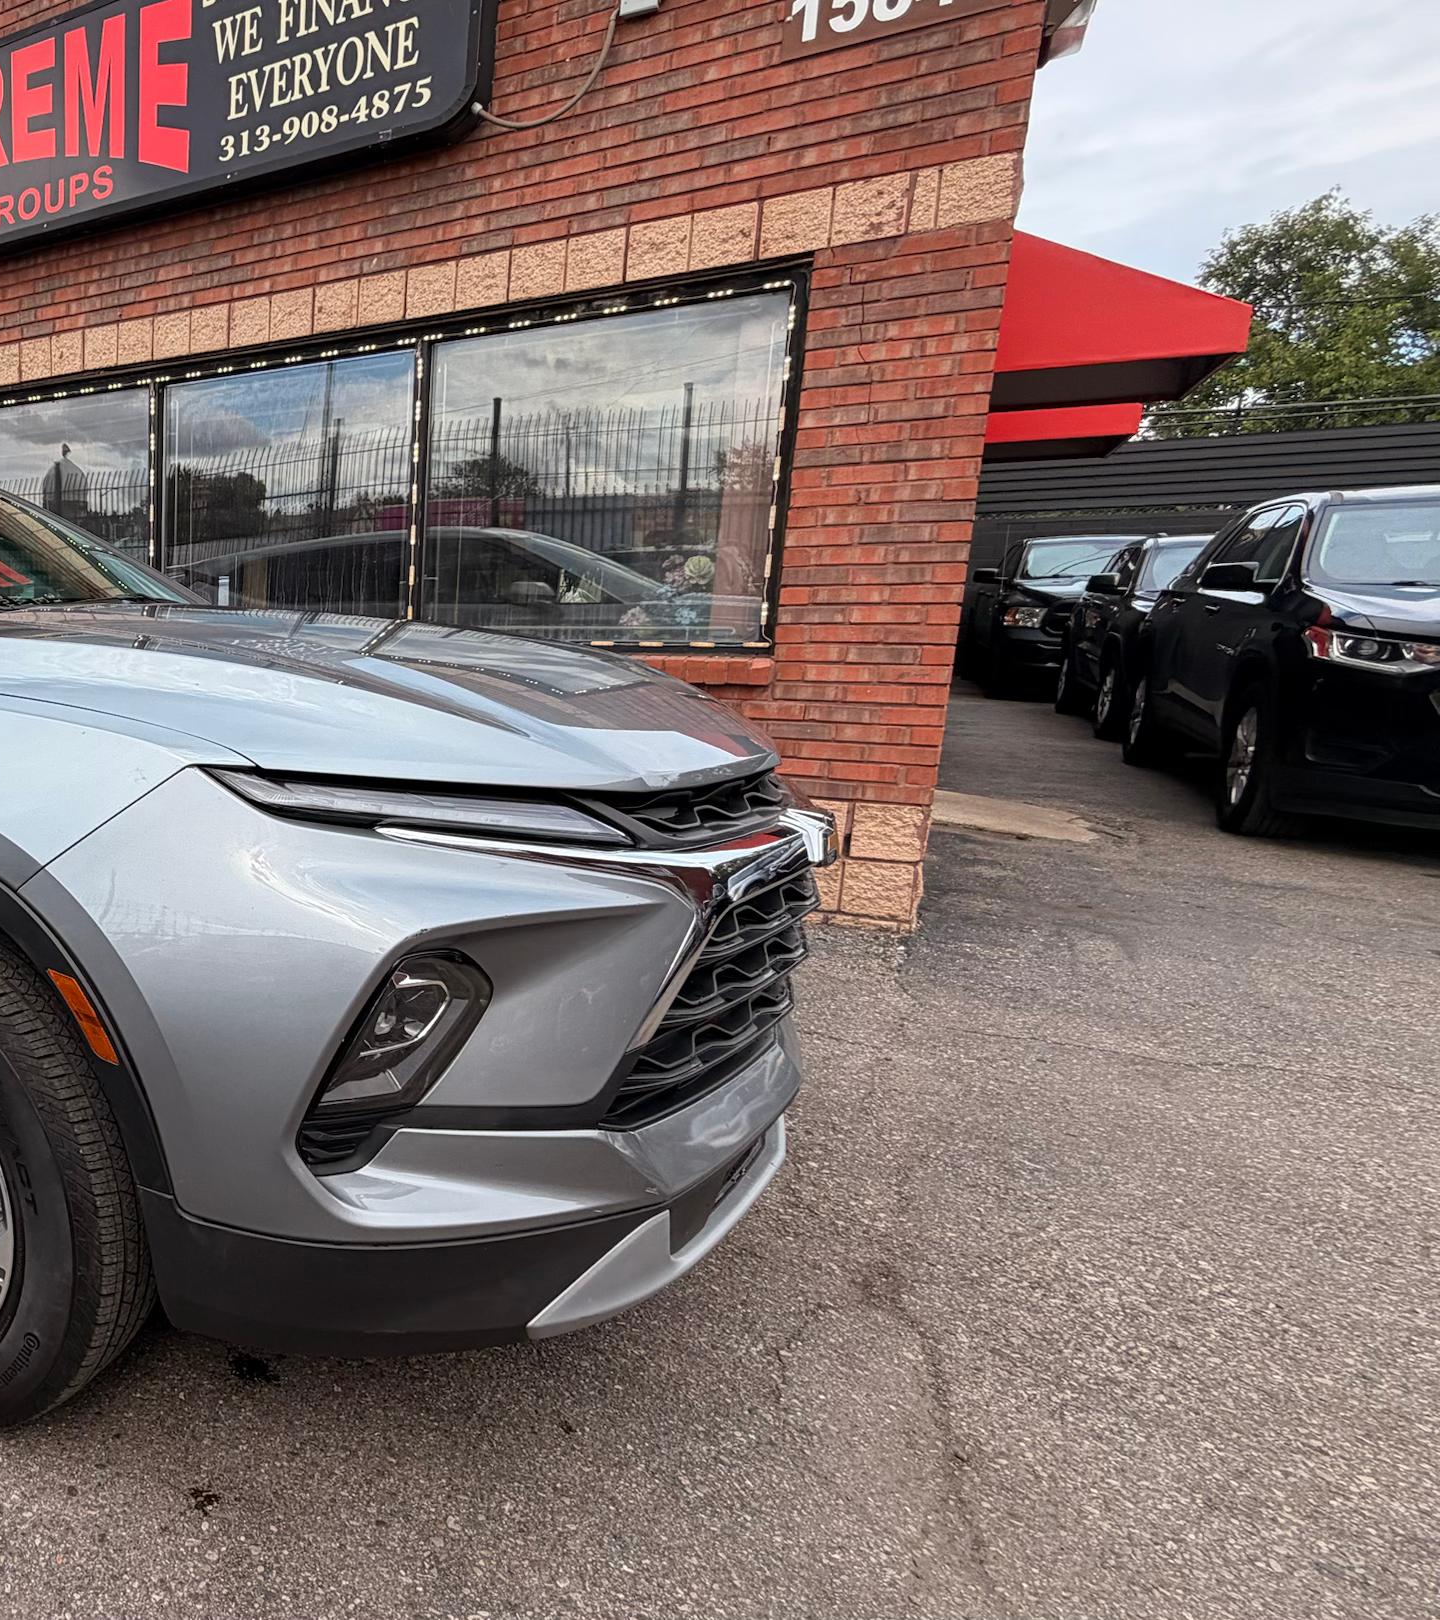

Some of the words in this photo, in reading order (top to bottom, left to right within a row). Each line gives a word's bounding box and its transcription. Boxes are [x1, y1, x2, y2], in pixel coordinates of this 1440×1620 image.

[212, 6, 263, 64] WE
[227, 16, 419, 120] EVERYONE
[218, 76, 432, 161] 313-908-4875
